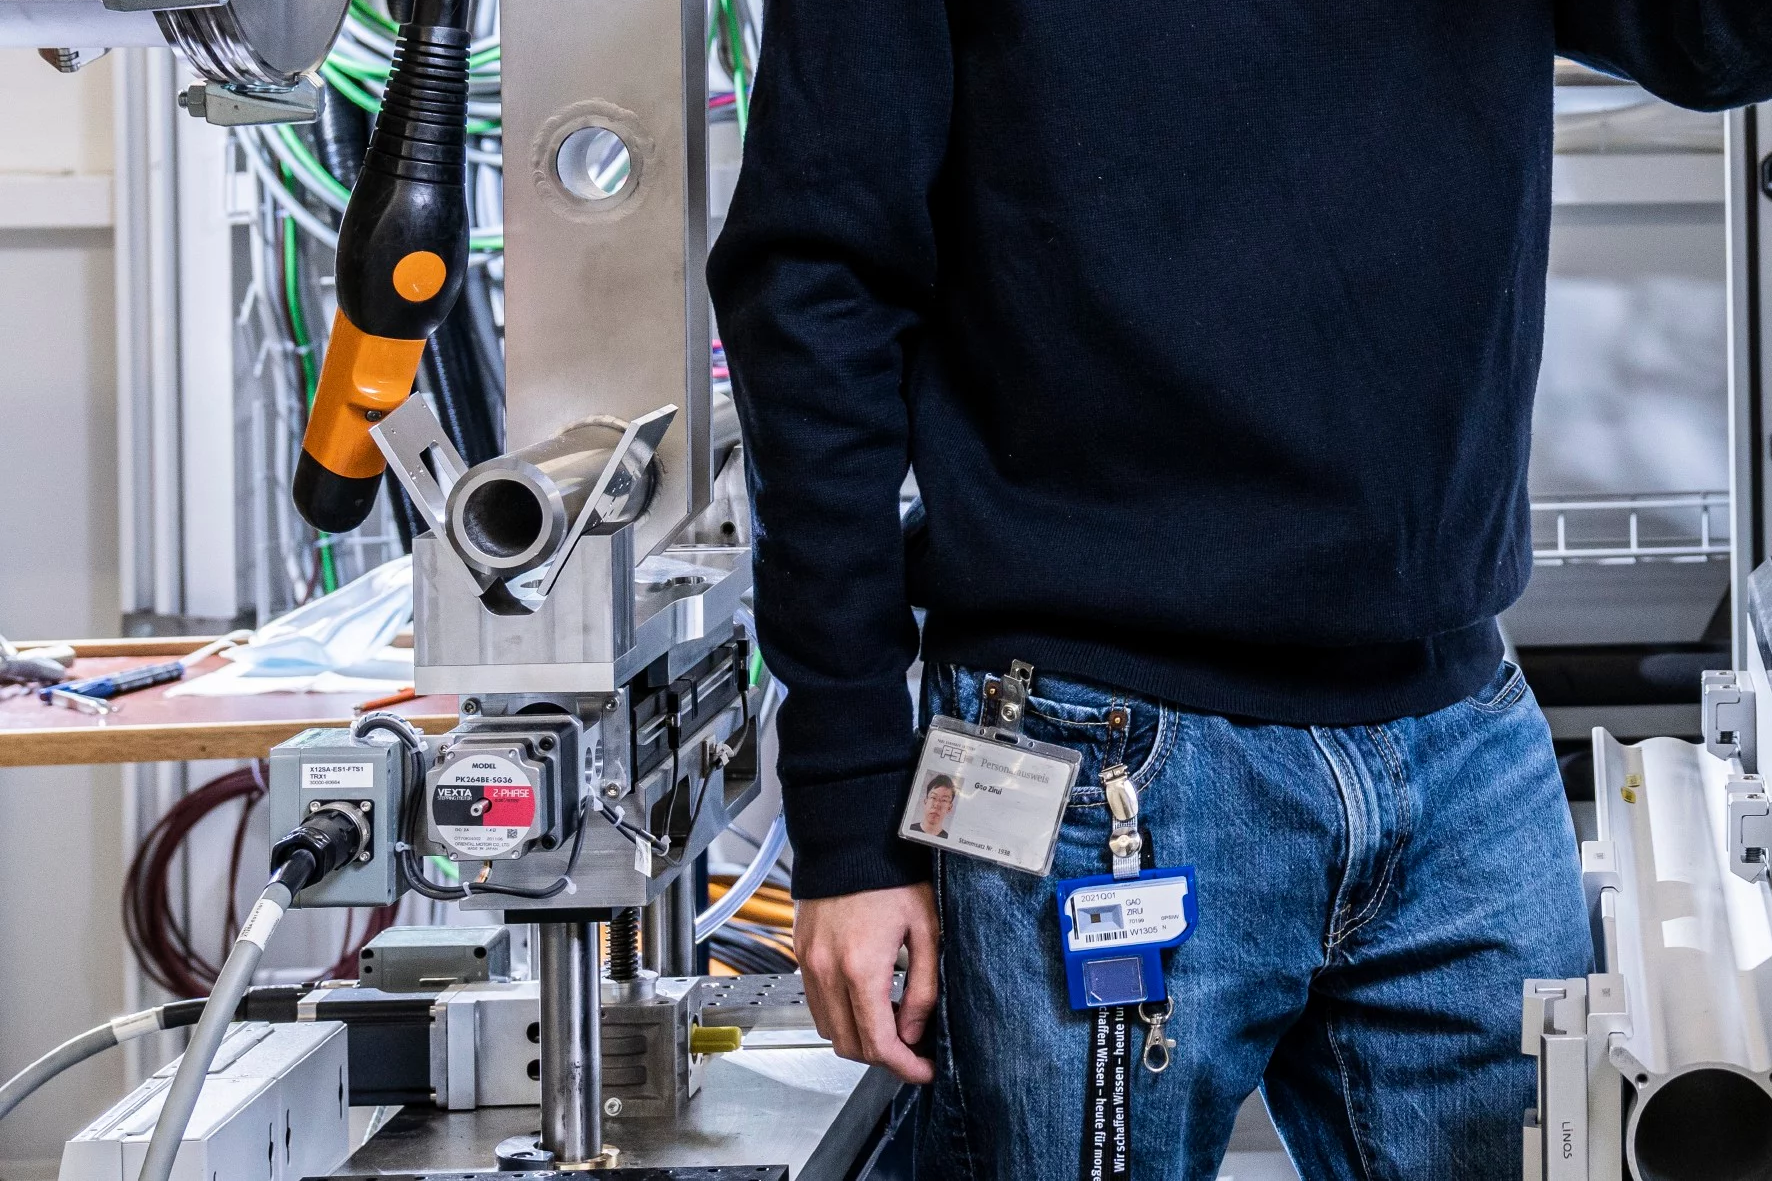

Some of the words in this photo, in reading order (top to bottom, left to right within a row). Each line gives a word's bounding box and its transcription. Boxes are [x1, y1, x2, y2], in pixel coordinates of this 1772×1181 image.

[940, 744, 967, 764] PSI
[980, 758, 1050, 784] Personaausweis
[437, 788, 473, 797] VEXTA
[492, 788, 530, 798] 2-PHASE
[987, 785, 1003, 796] Zirui
[958, 837, 986, 851] Stammsatz
[997, 847, 1011, 857] 1938
[1081, 892, 1116, 903] 2021Q01
[1125, 898, 1141, 906] GAO
[1126, 907, 1144, 916] ZIRUI
[1130, 926, 1158, 936] W1305
[1113, 1023, 1125, 1056] heute
[1095, 1048, 1108, 1087] Wissen
[1112, 1067, 1124, 1105] Wissen
[1094, 1098, 1107, 1128] heute
[1094, 1132, 1107, 1147] für
[1112, 1107, 1126, 1154] schaffen
[1113, 1154, 1126, 1173] Wir
